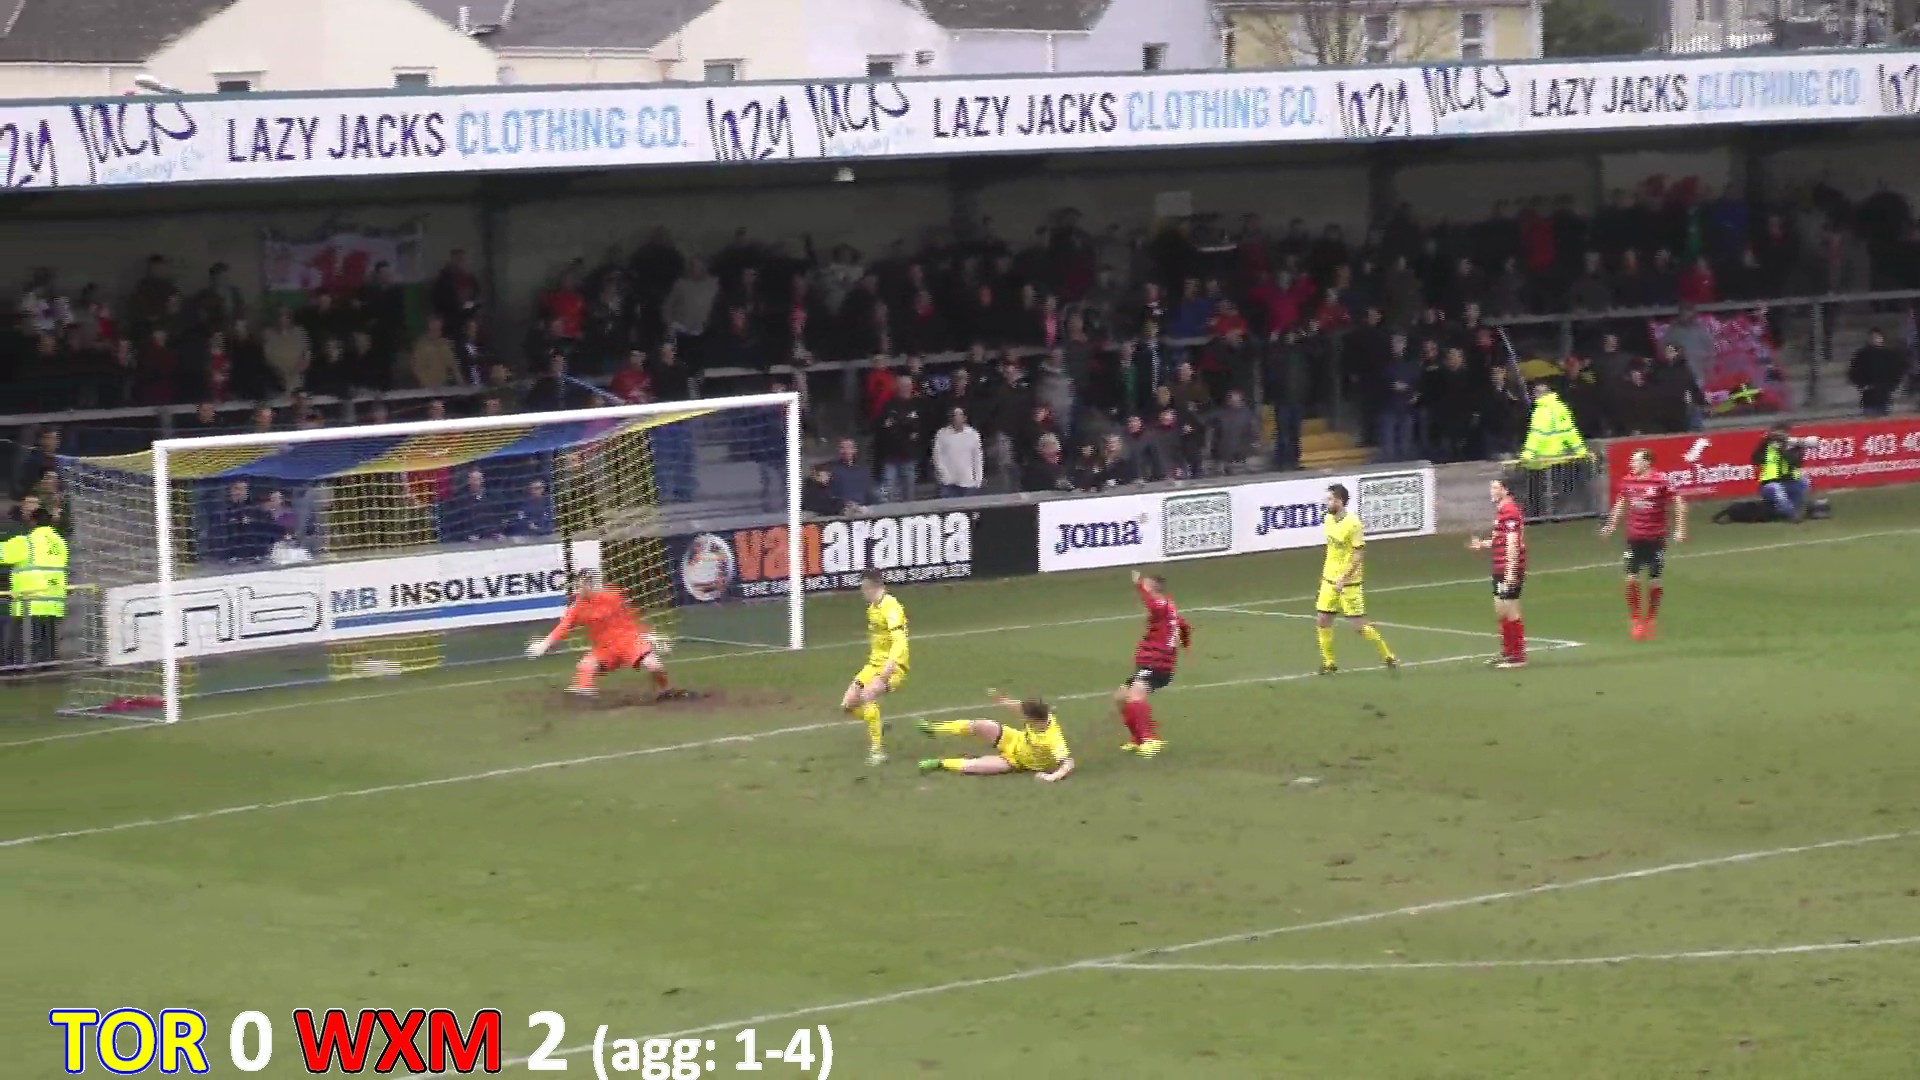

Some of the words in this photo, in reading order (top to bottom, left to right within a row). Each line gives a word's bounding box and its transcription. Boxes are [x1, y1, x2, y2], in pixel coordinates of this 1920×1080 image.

[1529, 78, 1597, 118] LAZY
[1603, 73, 1689, 113] JACKS
[1695, 69, 1820, 111] CLOTHING
[933, 95, 1009, 138] LAZY
[1016, 92, 1117, 135] JACKS
[1126, 88, 1270, 132] CLOTHING
[227, 115, 319, 163] LAZY
[328, 113, 446, 160] JACKS
[456, 107, 625, 155] CLOTHING
[1864, 434, 1898, 456] 403
[1362, 475, 1419, 496] ANDREAS
[1166, 498, 1228, 518] ANDREAS
[1168, 516, 1228, 536] CARTER
[733, 512, 972, 582] vanarama
[1166, 531, 1230, 552] SPORTS
[331, 587, 378, 612] MB
[390, 569, 569, 607] INSOLVENC
[741, 582, 769, 598] THE
[842, 572, 864, 589] NE
[882, 567, 905, 583] AN
[907, 562, 971, 581] SUPPLIER
